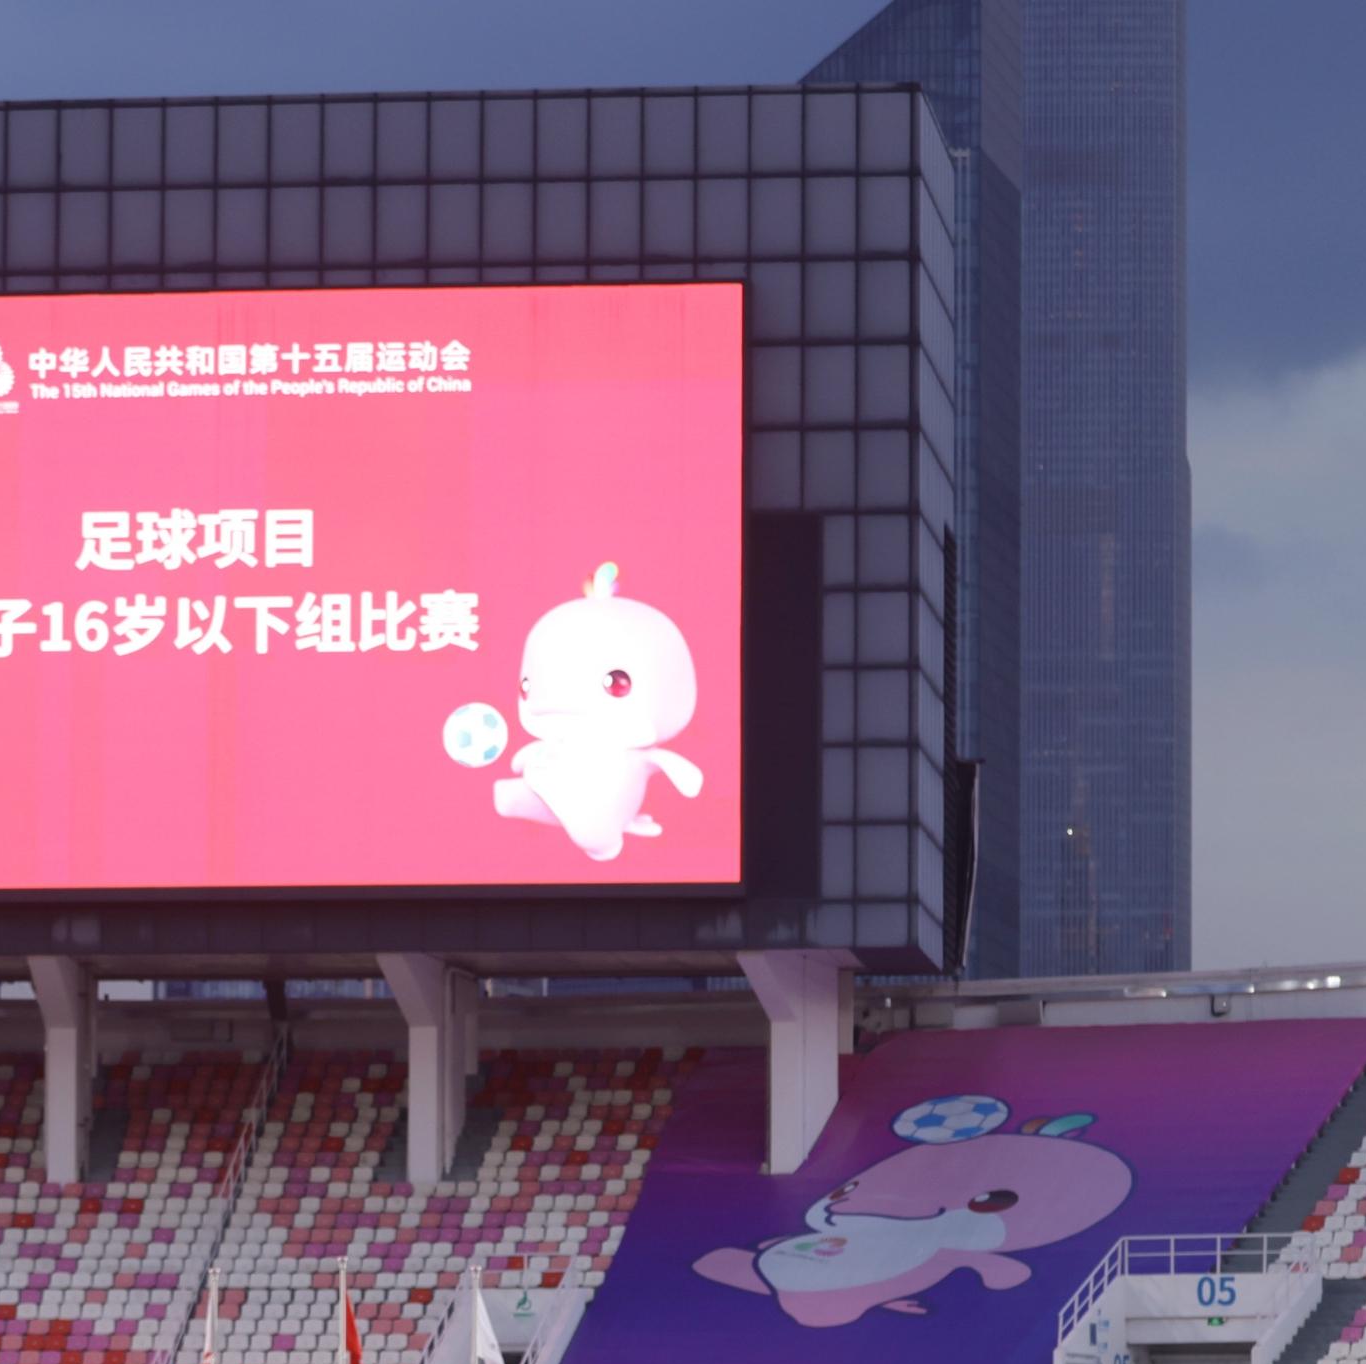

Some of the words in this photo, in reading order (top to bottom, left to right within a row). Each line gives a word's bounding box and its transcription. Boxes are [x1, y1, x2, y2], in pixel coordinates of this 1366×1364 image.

[28, 339, 472, 380] 中华人民共和国第十五届运动会
[29, 382, 60, 399] The
[63, 381, 97, 399] 15th
[100, 381, 164, 399] National
[167, 380, 221, 398] Games
[222, 379, 240, 396] of
[243, 379, 268, 396] the
[271, 378, 335, 397] People's
[337, 377, 404, 396] Republic
[407, 376, 425, 393] of
[426, 376, 472, 392] China
[75, 508, 314, 571] 足球项目
[1196, 1276, 1237, 1307] 05
